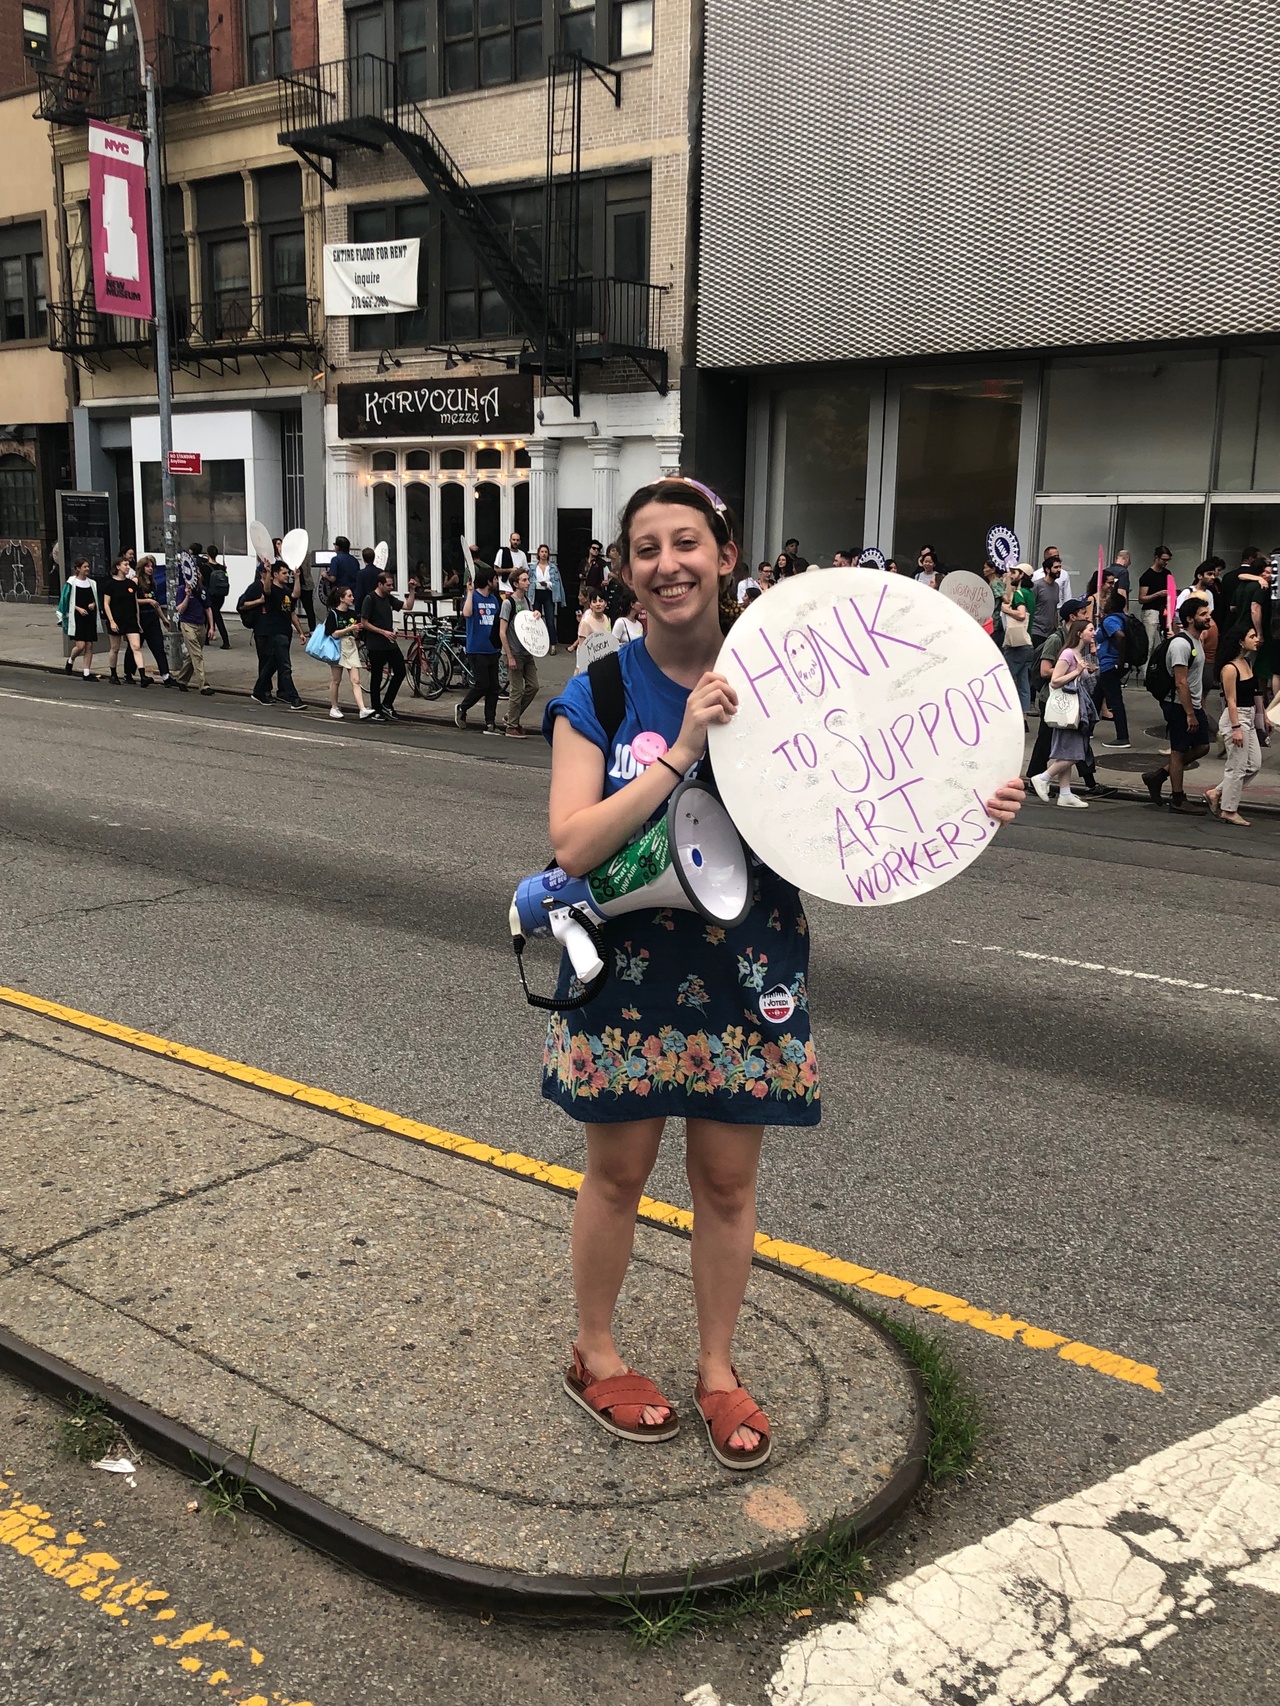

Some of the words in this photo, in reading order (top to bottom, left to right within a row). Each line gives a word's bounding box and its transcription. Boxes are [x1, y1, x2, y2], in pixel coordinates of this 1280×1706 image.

[104, 138, 130, 155] NYC
[333, 249, 355, 262] ENTIRE
[356, 248, 375, 261] FLOOR
[376, 246, 389, 260] FOR
[390, 245, 407, 259] RENT
[106, 279, 125, 291] NEW
[354, 271, 380, 287] inquire
[106, 285, 142, 302] MUSEUM
[364, 386, 500, 425] KARVOUNA
[440, 412, 480, 425] mezze
[995, 538, 1009, 559] UAW
[730, 584, 927, 719] HONK
[798, 659, 818, 681] UNION
[772, 733, 818, 772] TO
[823, 664, 1012, 793] SUPPORT
[835, 777, 925, 870] ART
[845, 788, 996, 903] WORKERS!
[613, 862, 630, 884] that's
[619, 863, 638, 894] UNFAIR!
[767, 999, 789, 1007] VOTED!
